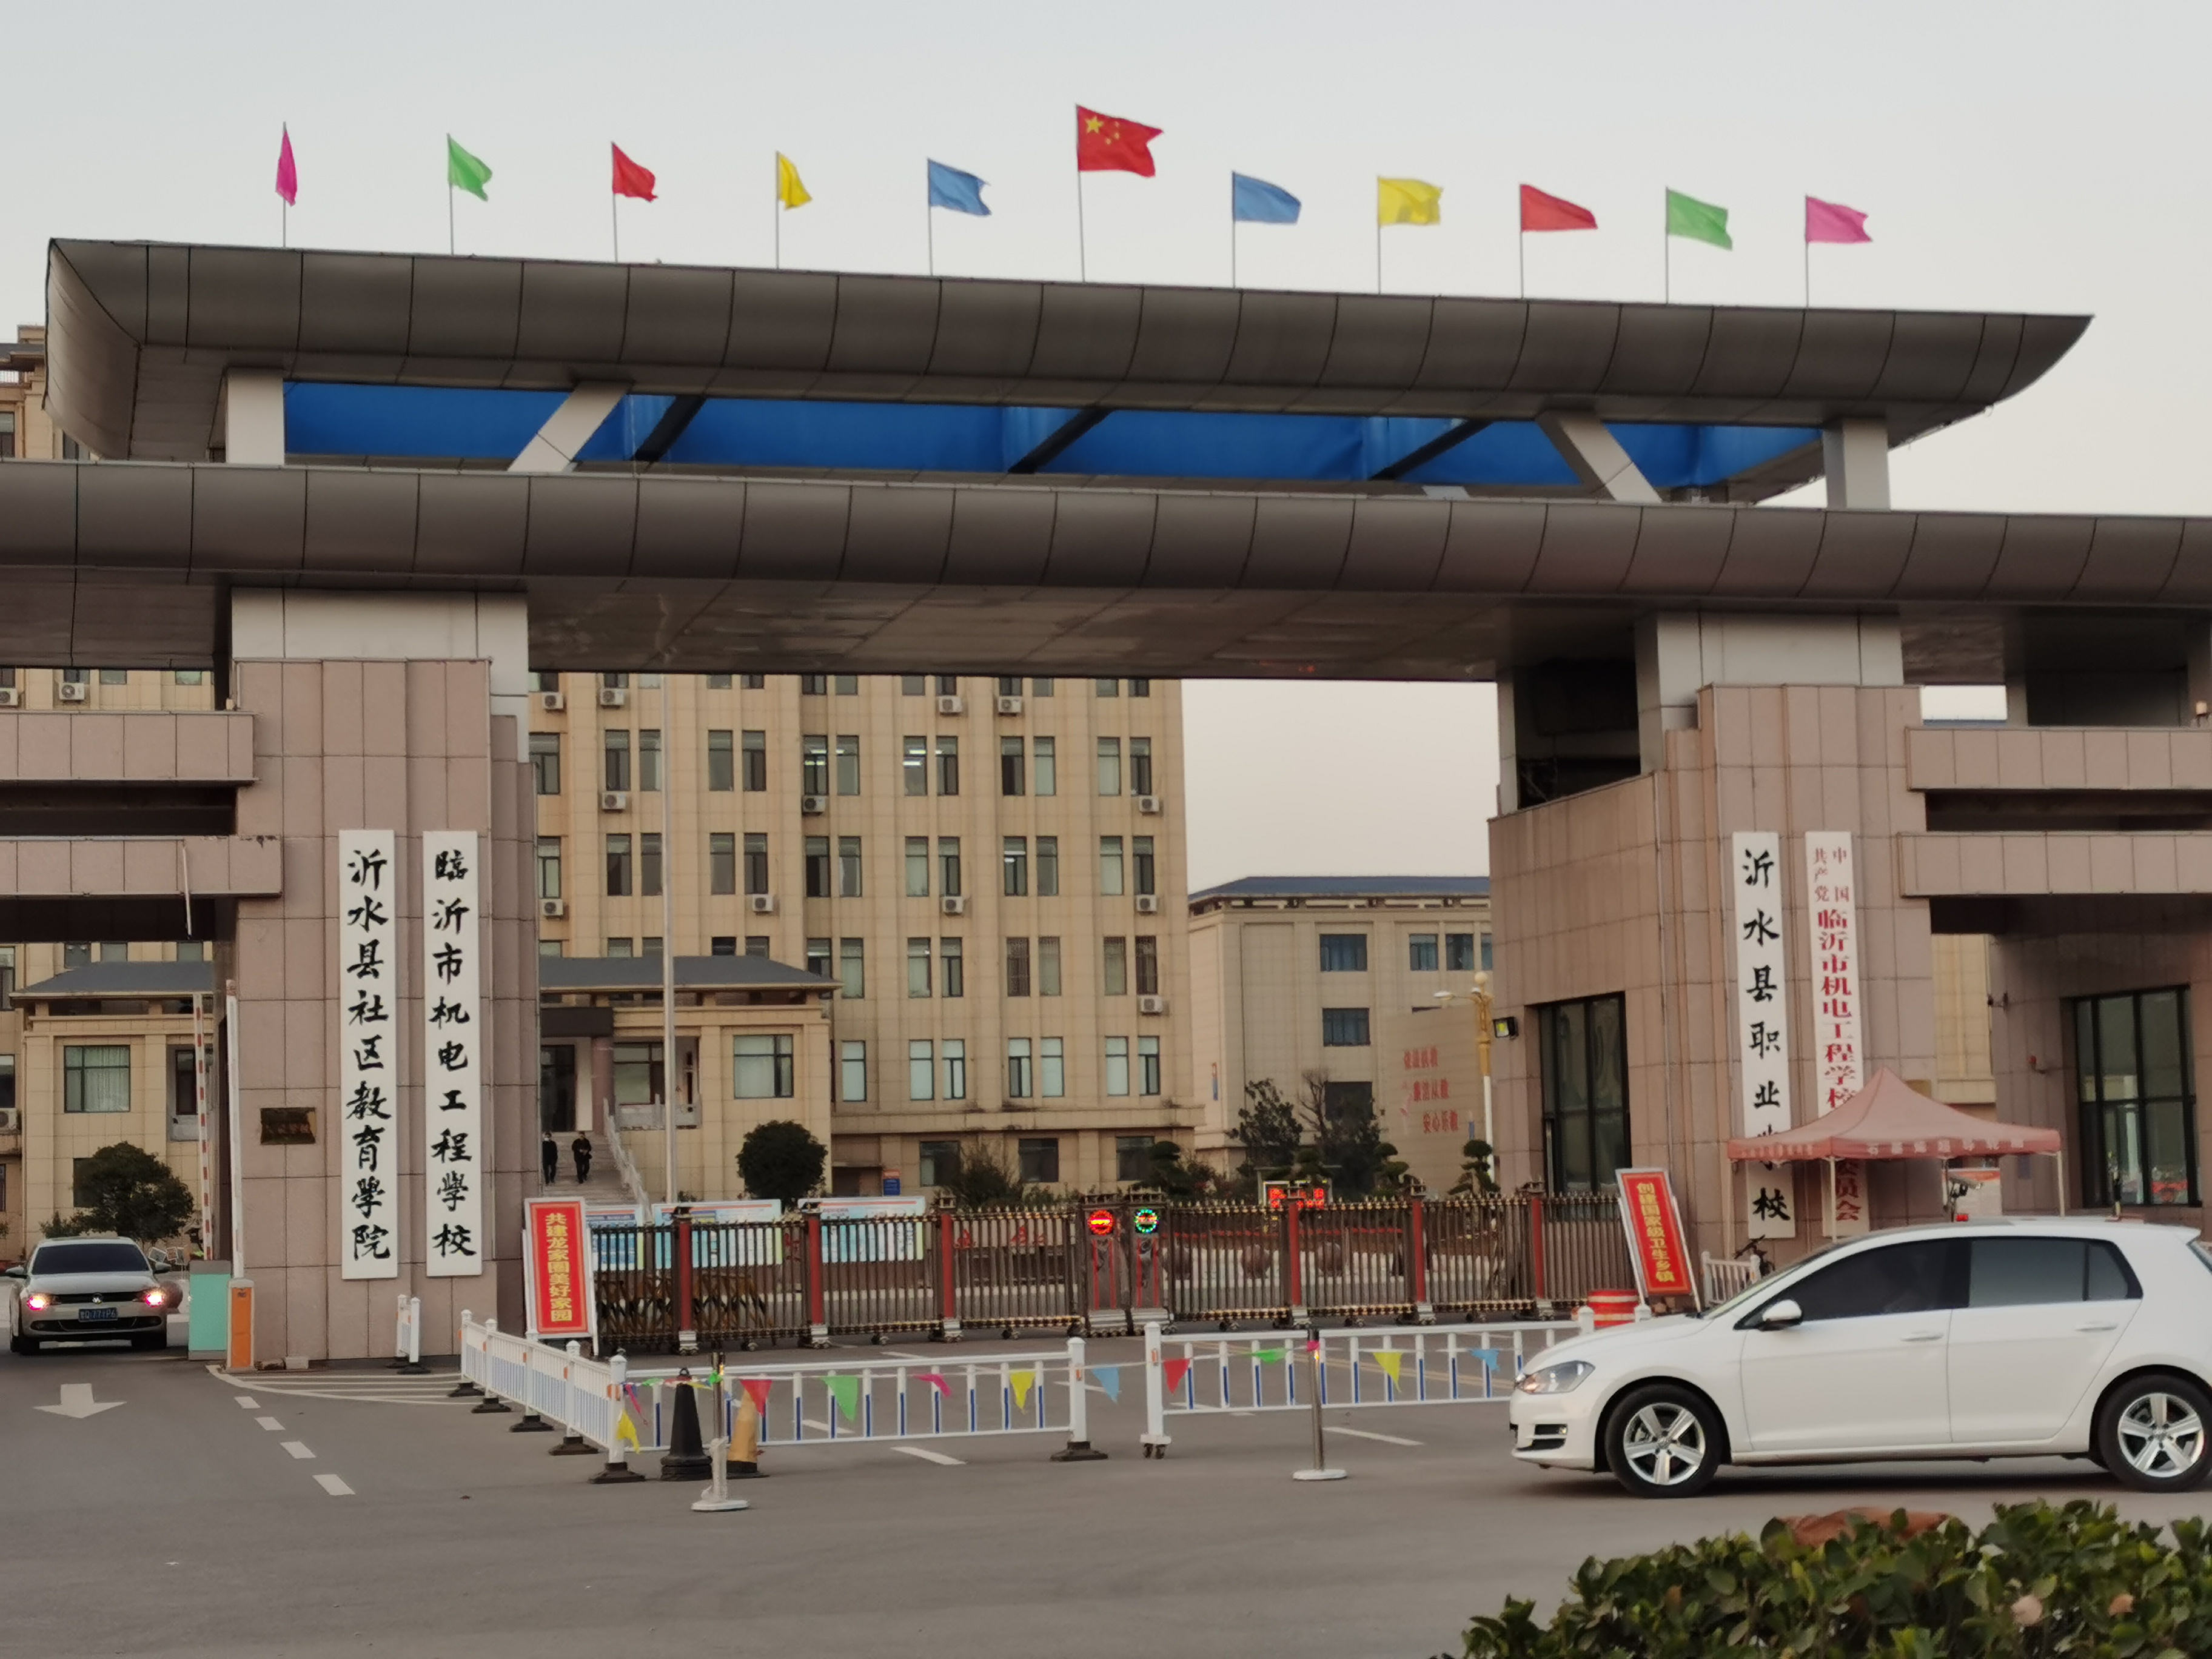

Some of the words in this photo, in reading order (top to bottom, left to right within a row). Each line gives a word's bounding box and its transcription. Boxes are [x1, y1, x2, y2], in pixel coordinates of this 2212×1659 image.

[1743, 849, 1791, 1221] 沂水县职业校
